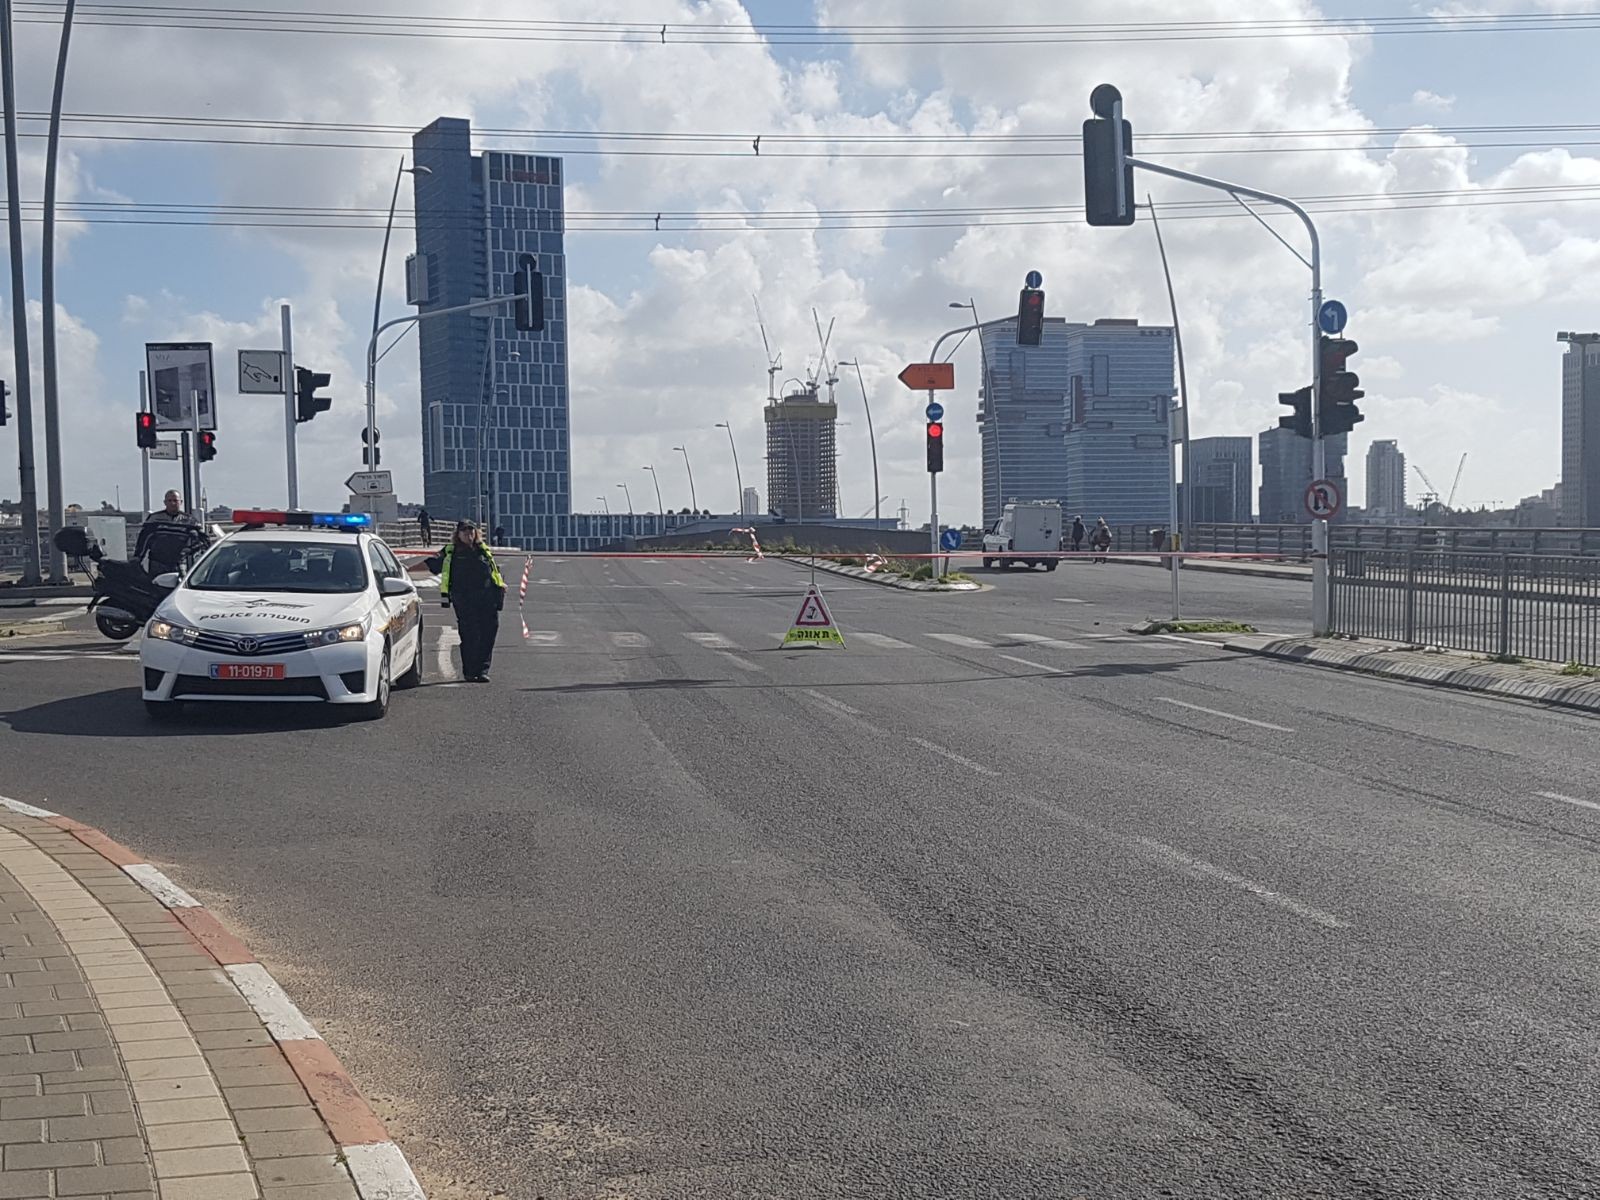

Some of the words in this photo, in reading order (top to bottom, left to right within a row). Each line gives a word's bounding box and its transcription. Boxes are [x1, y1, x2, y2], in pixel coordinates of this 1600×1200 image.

[199, 612, 253, 621] POLICE
[257, 612, 311, 624] משטרה
[797, 630, 830, 639] תאונה
